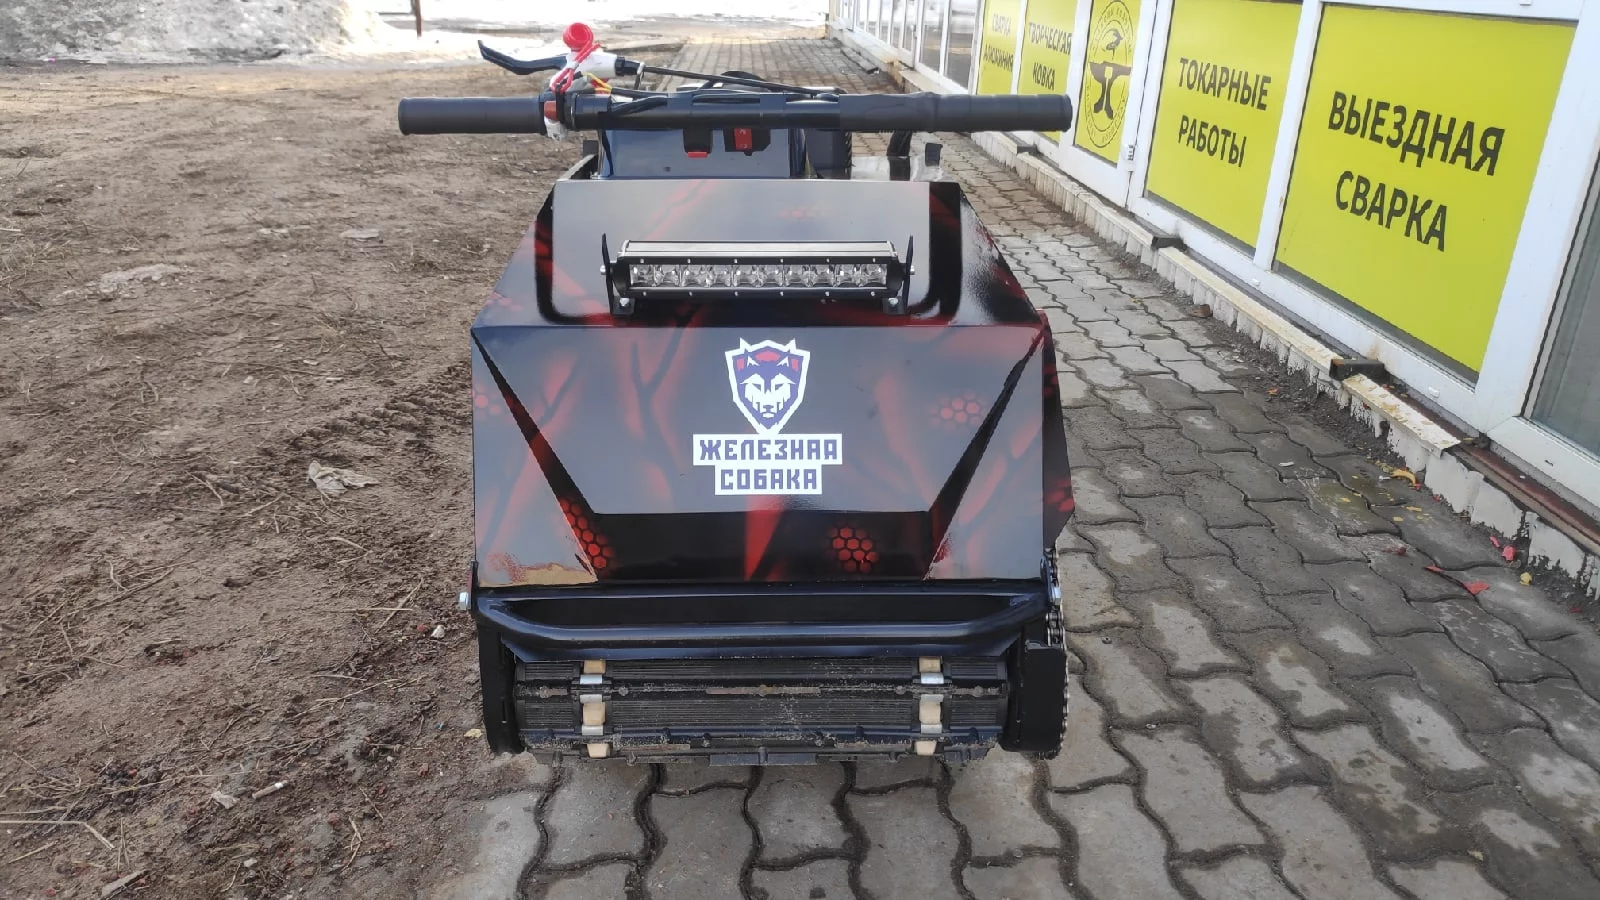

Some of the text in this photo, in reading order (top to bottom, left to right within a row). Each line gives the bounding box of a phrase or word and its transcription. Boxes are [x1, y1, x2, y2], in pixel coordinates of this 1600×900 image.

[1029, 22, 1072, 56] ТВОРЧЕСКАЯ
[1033, 62, 1055, 91] КОВКА
[1178, 57, 1272, 111] ТОКАРНЫЕ
[1178, 115, 1248, 168] РАБОТЫ
[1328, 91, 1505, 176] ВЫЕЗДНАЯ
[1336, 170, 1448, 252] СВАРКА
[700, 440, 838, 460] ЖЕЛЕЗНАЯ
[721, 469, 817, 490] СОБАКА
